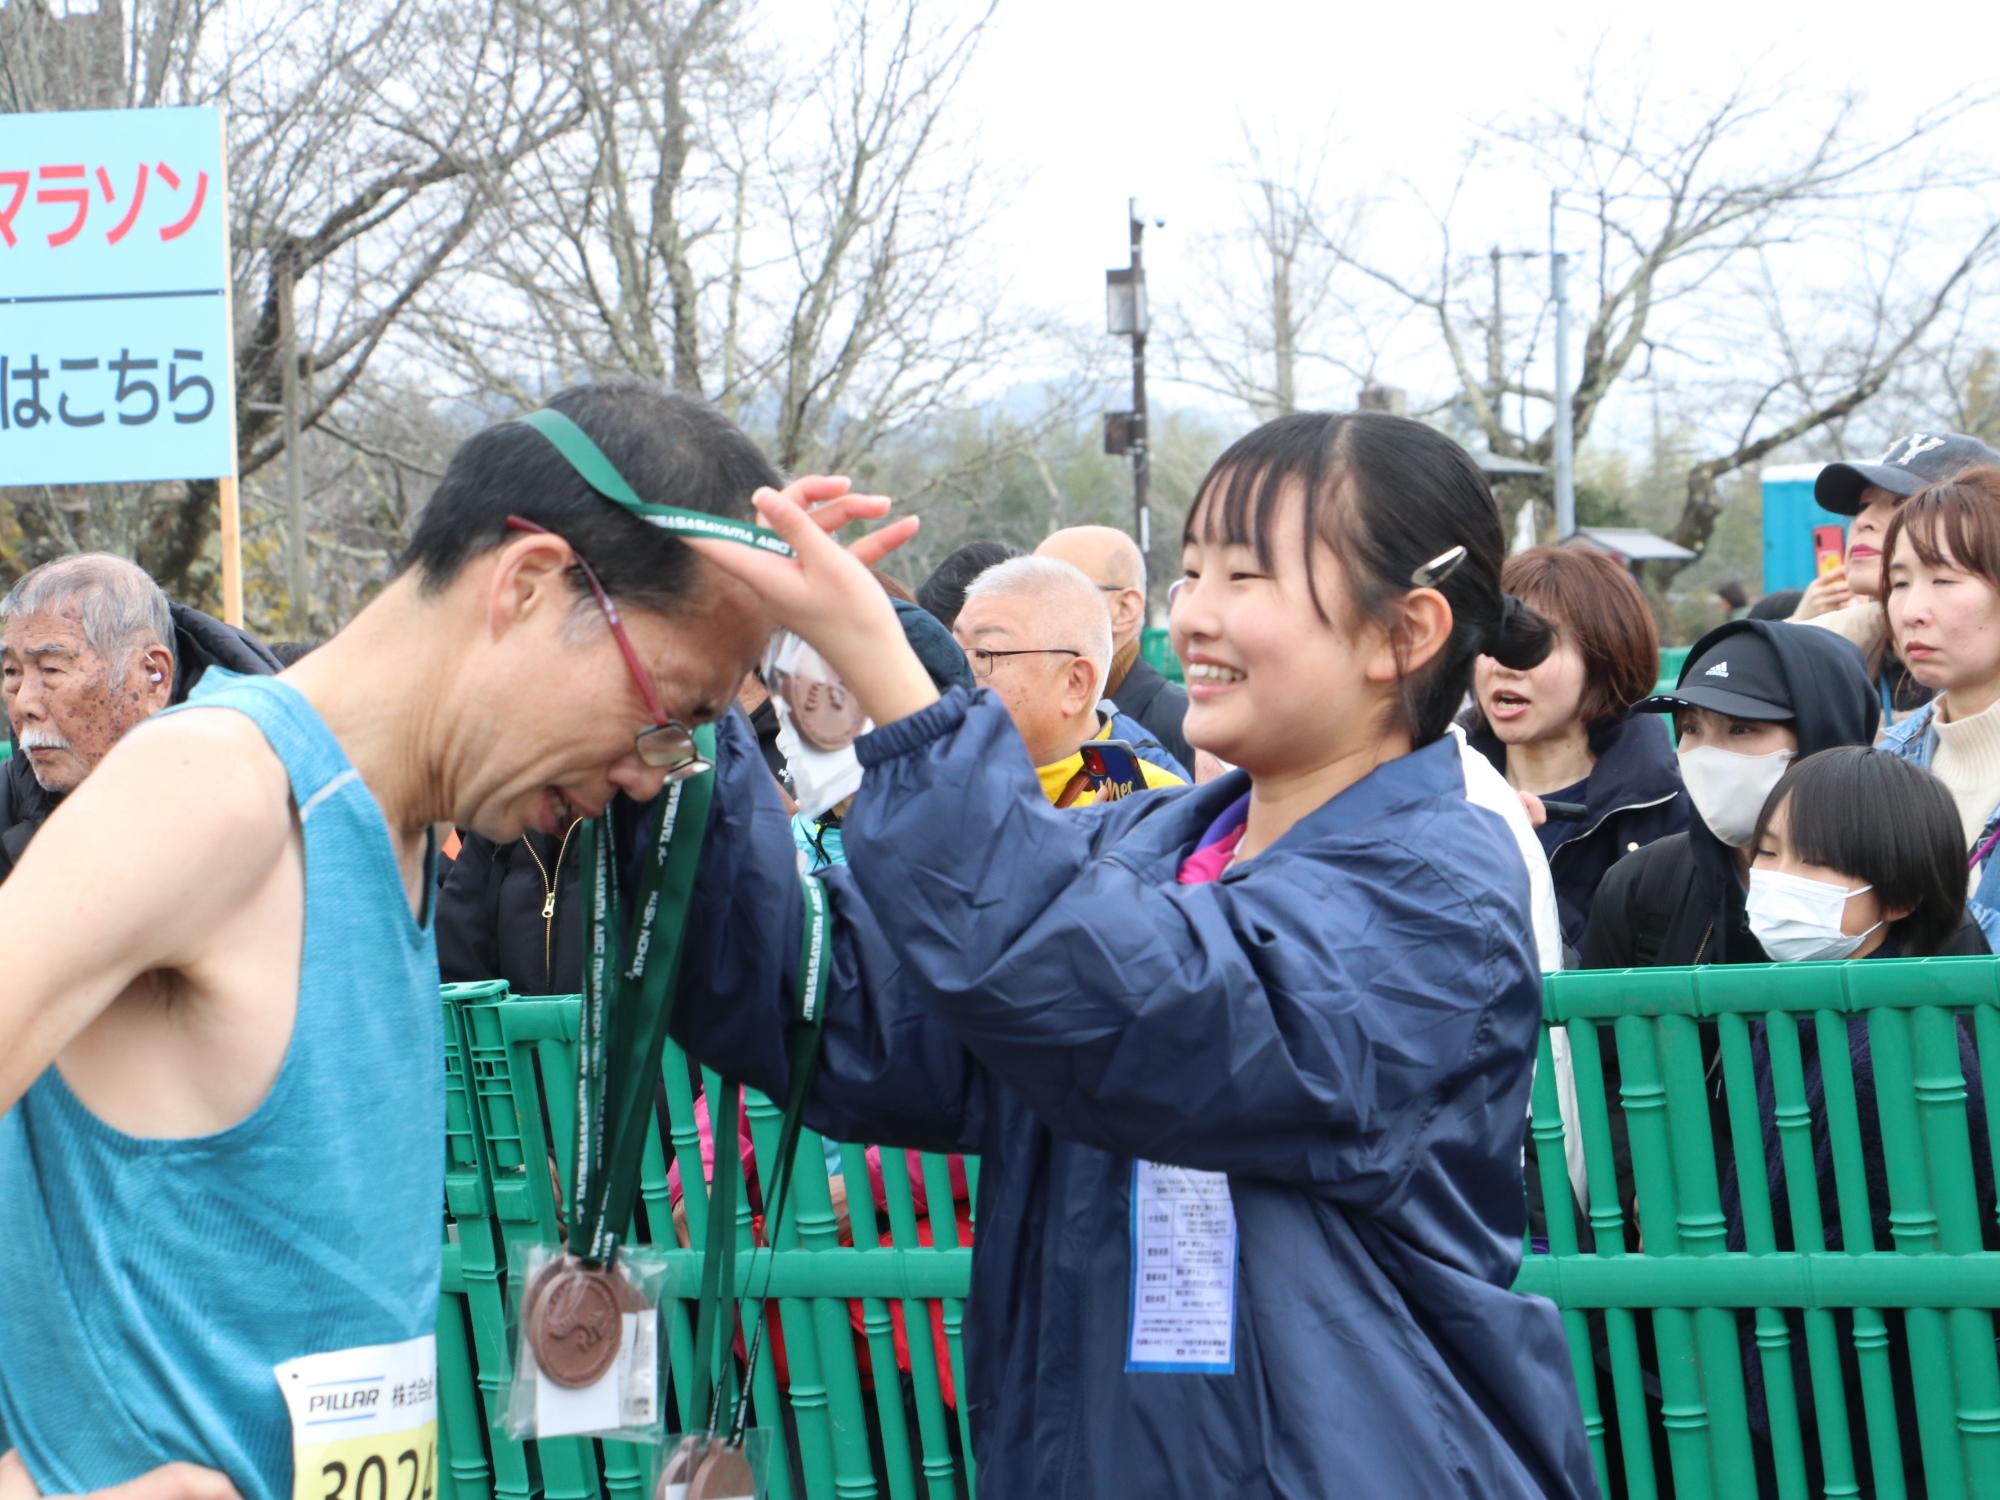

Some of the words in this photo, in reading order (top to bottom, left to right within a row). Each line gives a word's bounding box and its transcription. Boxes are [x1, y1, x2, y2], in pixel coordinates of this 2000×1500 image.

[0, 161, 208, 248] マラソン
[0, 348, 214, 430] はこちら
[594, 923, 606, 955] ABC
[592, 957, 605, 1038] MARATHON
[309, 1388, 381, 1413] PILLAR
